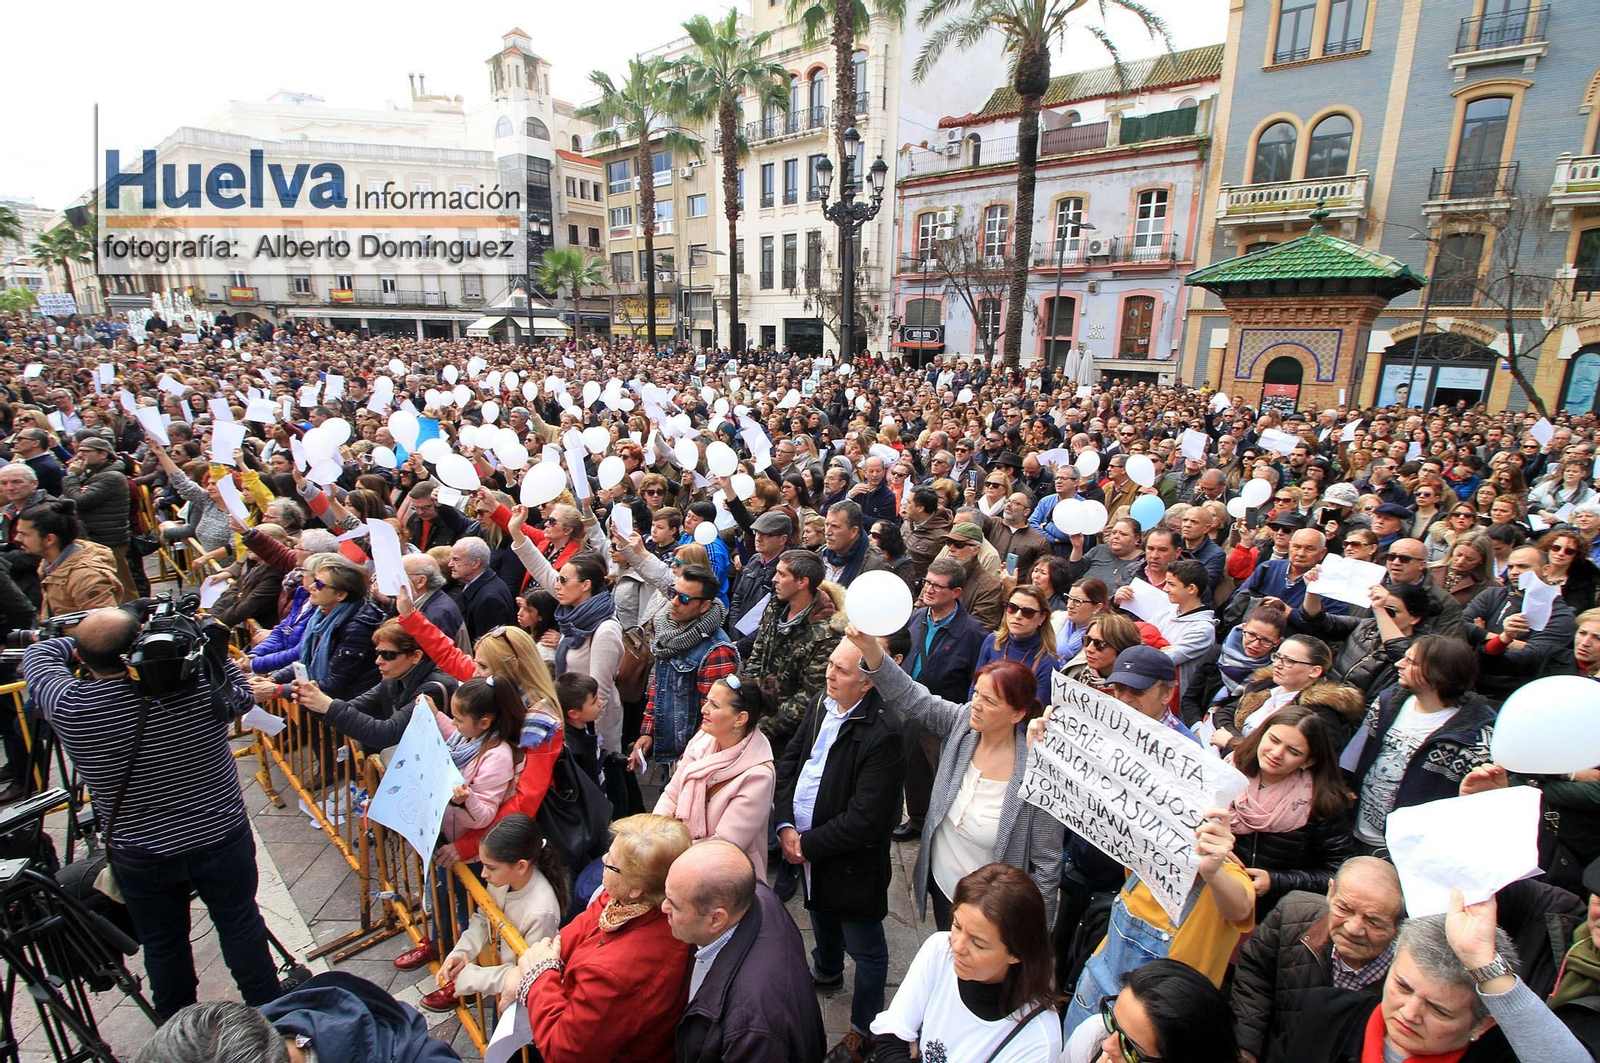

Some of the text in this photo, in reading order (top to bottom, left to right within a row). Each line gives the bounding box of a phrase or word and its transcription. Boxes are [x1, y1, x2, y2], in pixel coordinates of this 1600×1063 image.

[1107, 748, 1151, 788] RUTH
[1025, 785, 1036, 799] Y
[1029, 771, 1077, 813] TODAS
[1142, 839, 1181, 883] POR
